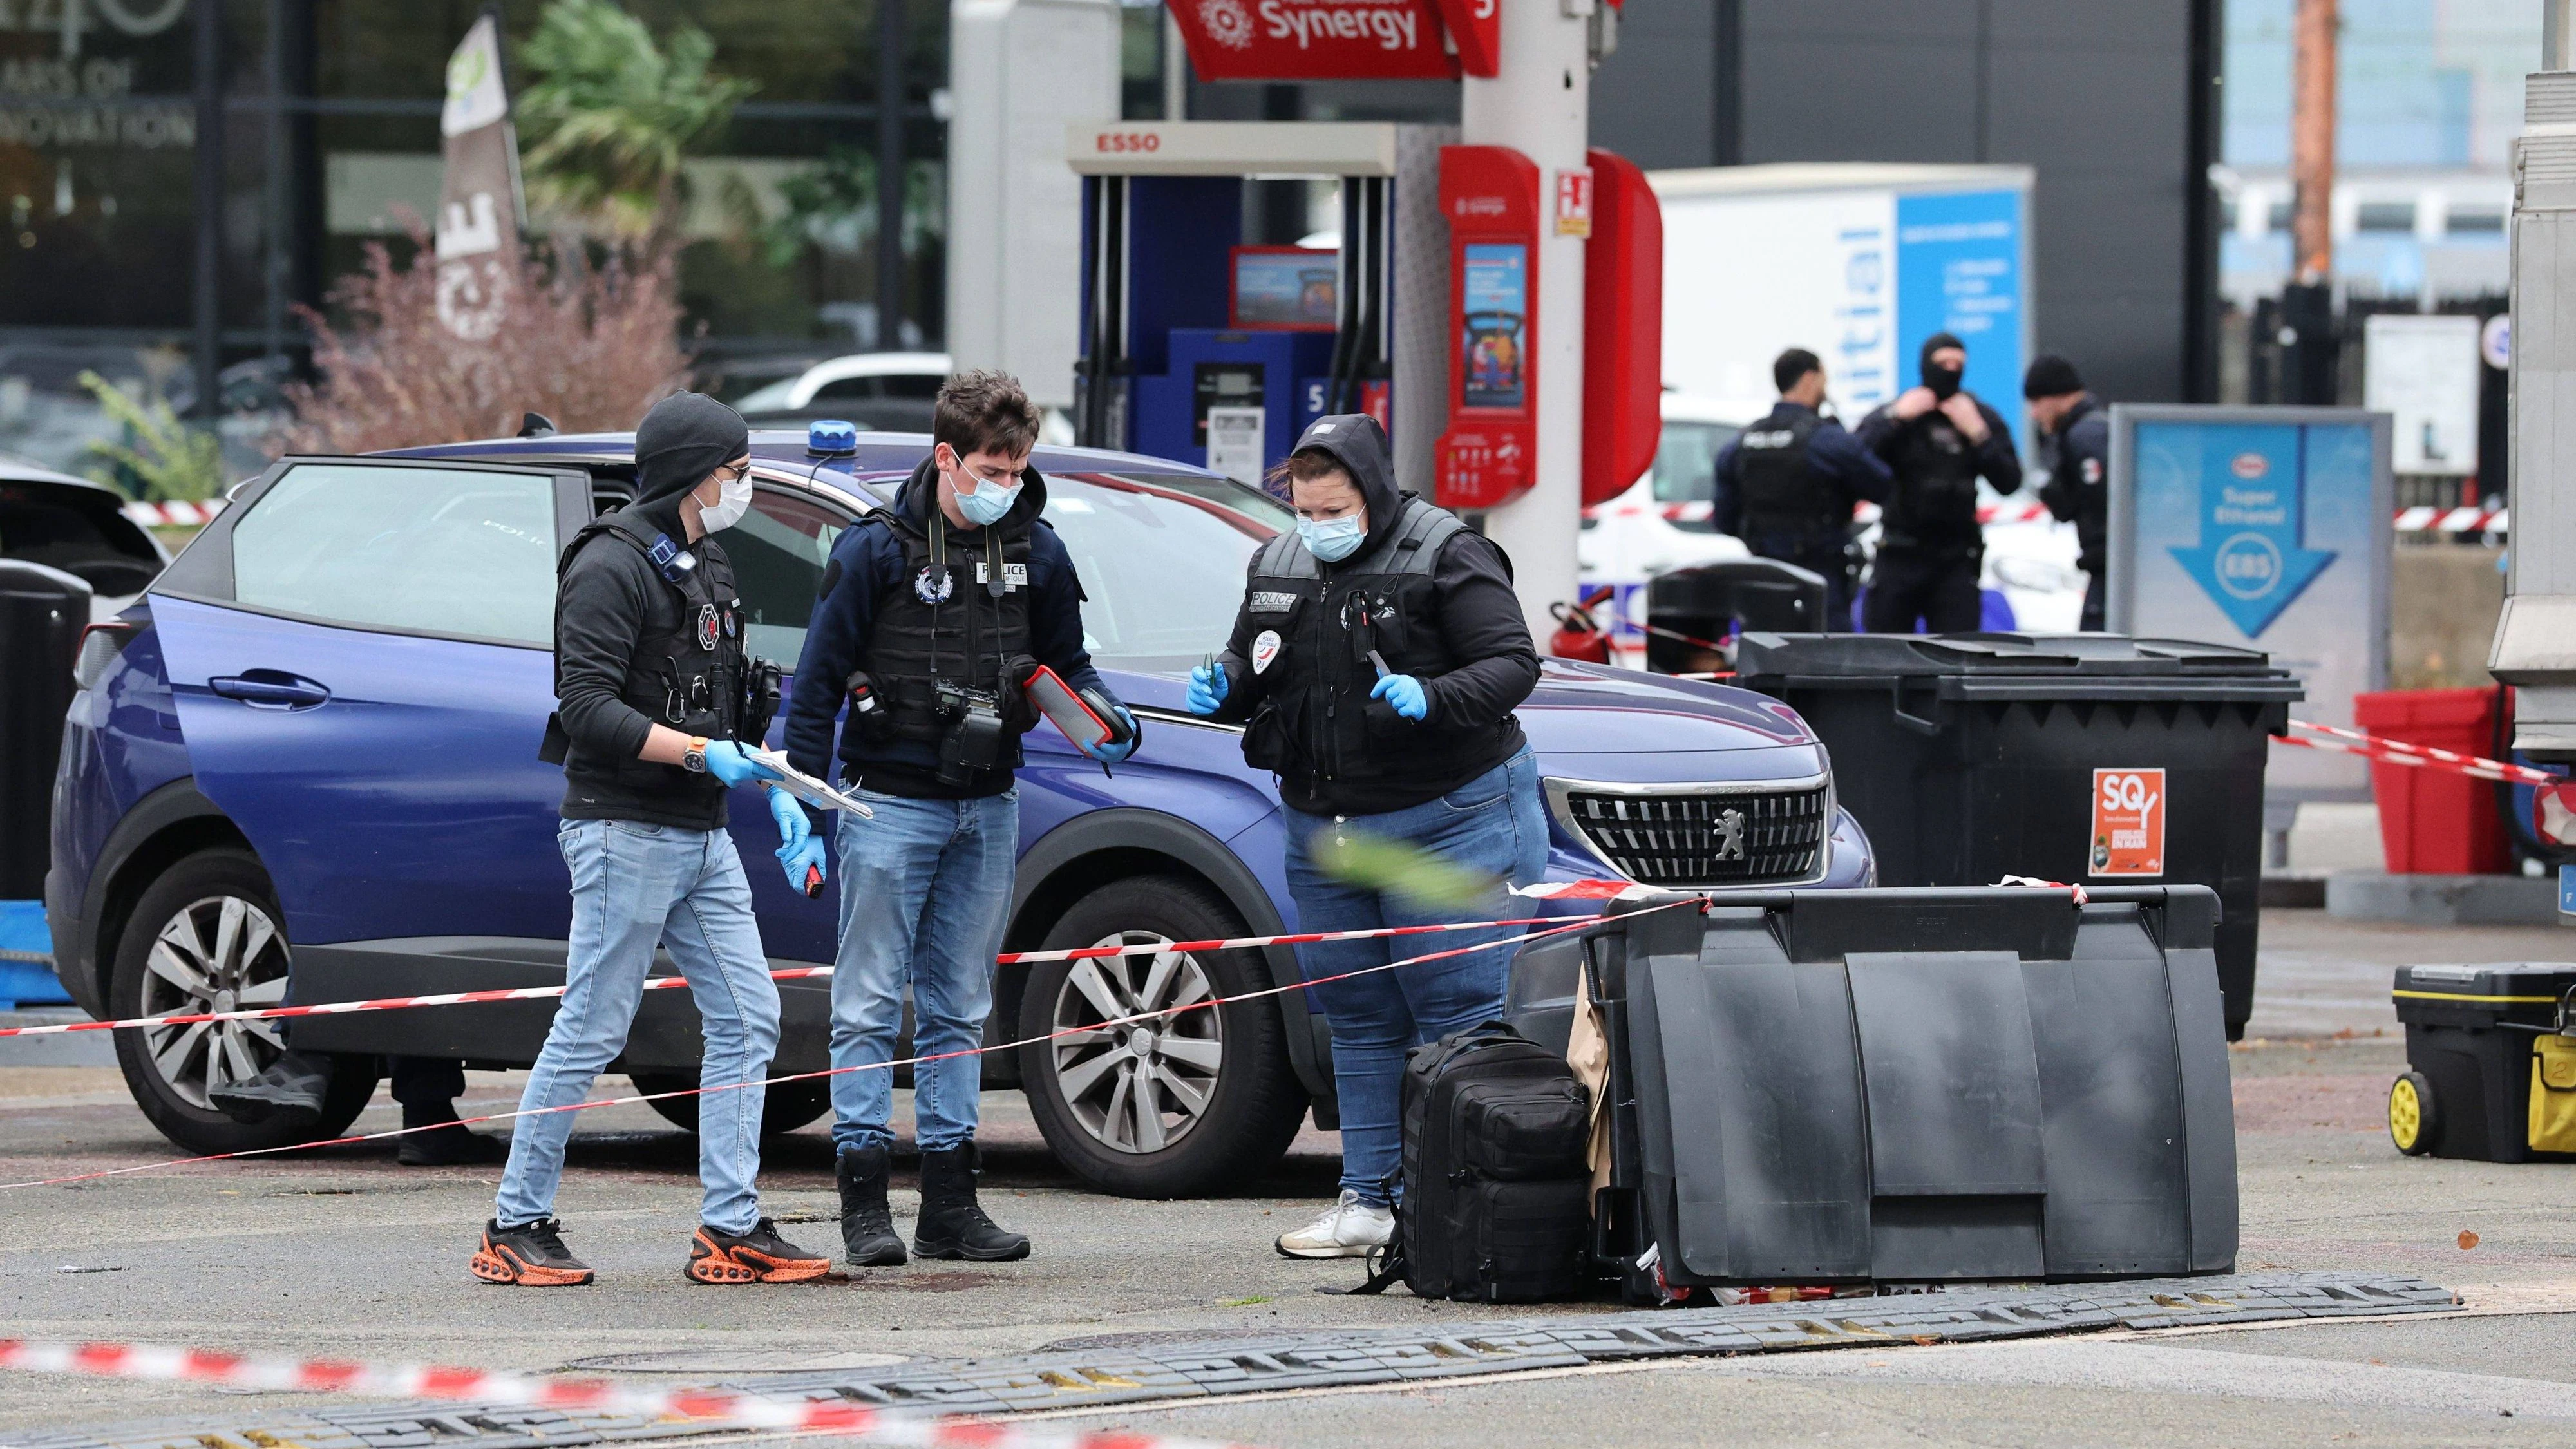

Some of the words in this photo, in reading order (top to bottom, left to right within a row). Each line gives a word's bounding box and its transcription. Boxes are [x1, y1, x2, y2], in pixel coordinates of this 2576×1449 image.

[1258, 1, 1417, 50] Synergy
[1096, 132, 1160, 152] ESSO
[1308, 384, 1324, 412] 5
[982, 565, 1025, 575] PICE
[1252, 592, 1296, 605] POLICE
[2101, 774, 2159, 829] SQY
[2566, 892, 2573, 903] F
[2552, 1062, 2566, 1079] 2
